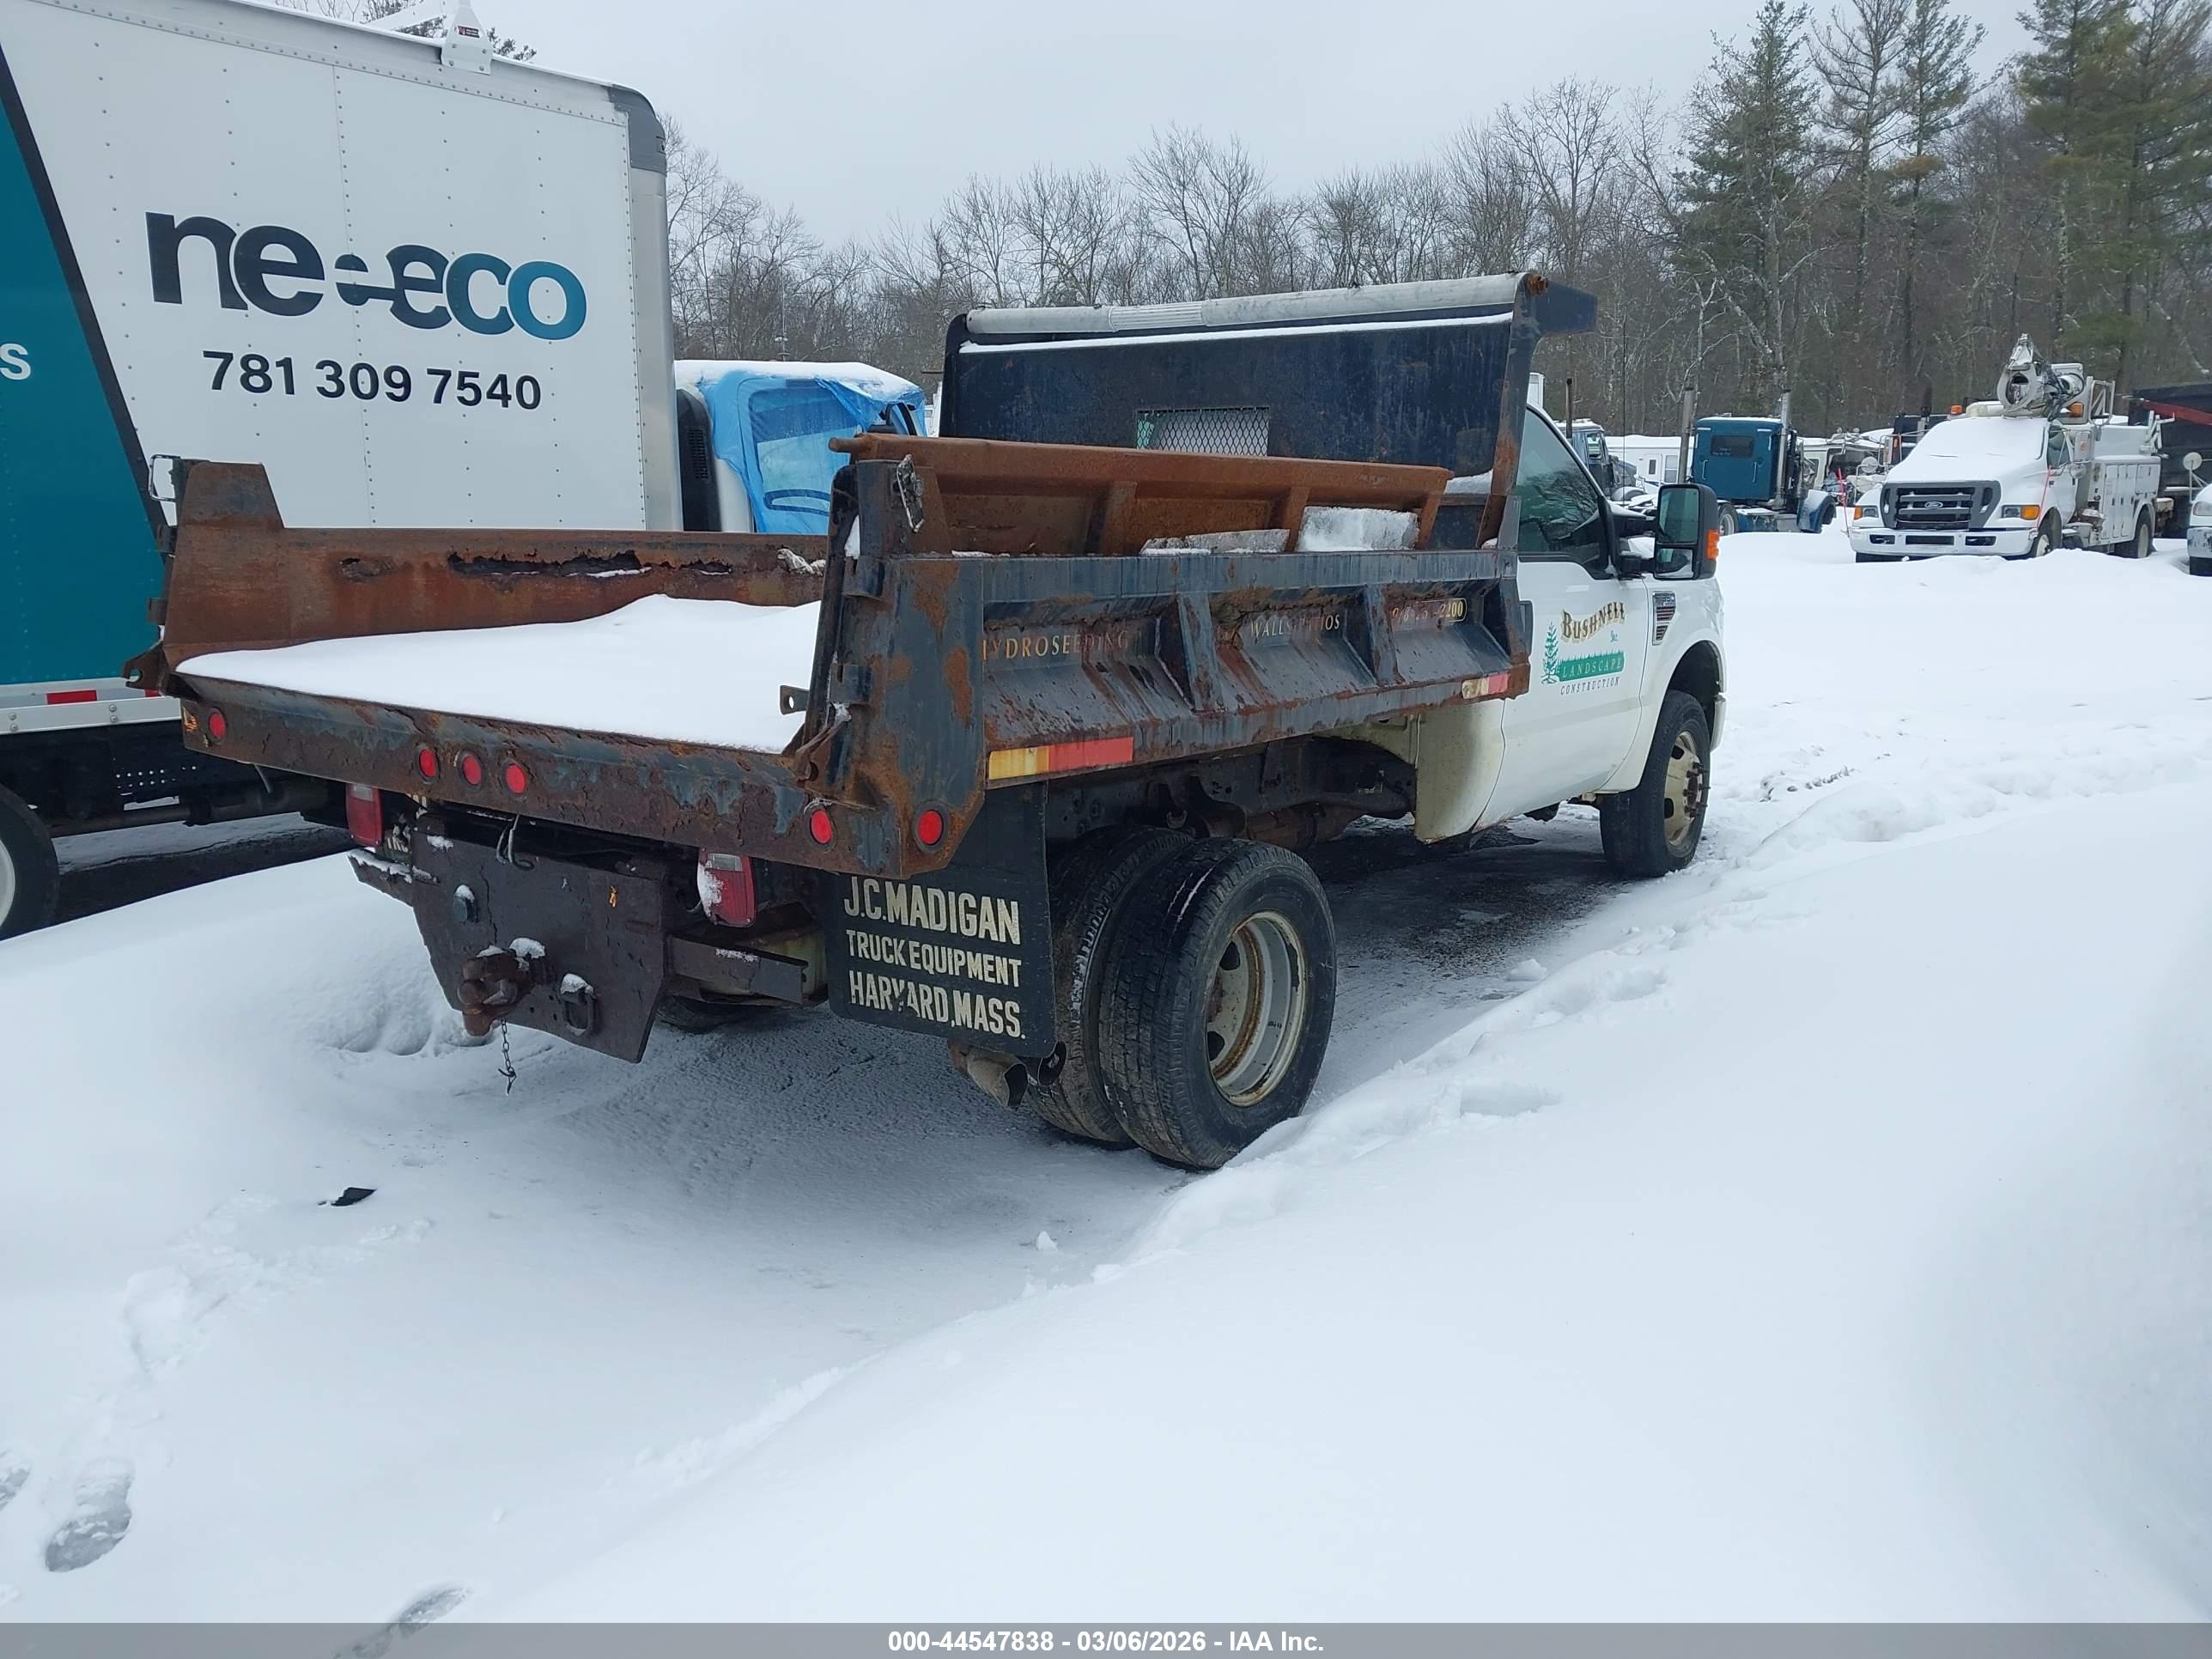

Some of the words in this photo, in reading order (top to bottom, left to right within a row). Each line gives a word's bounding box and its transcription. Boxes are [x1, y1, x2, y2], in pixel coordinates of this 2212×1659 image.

[203, 349, 295, 395] 781
[315, 359, 412, 402] 309
[426, 368, 541, 410] 7540
[1562, 600, 1626, 642] BUSHNELL
[1560, 677, 1620, 696] CONSTRUCTION
[1563, 658, 1621, 678] LANDSCAPE
[846, 929, 907, 967] TRUCK
[909, 941, 1022, 988] EQUIPMENT
